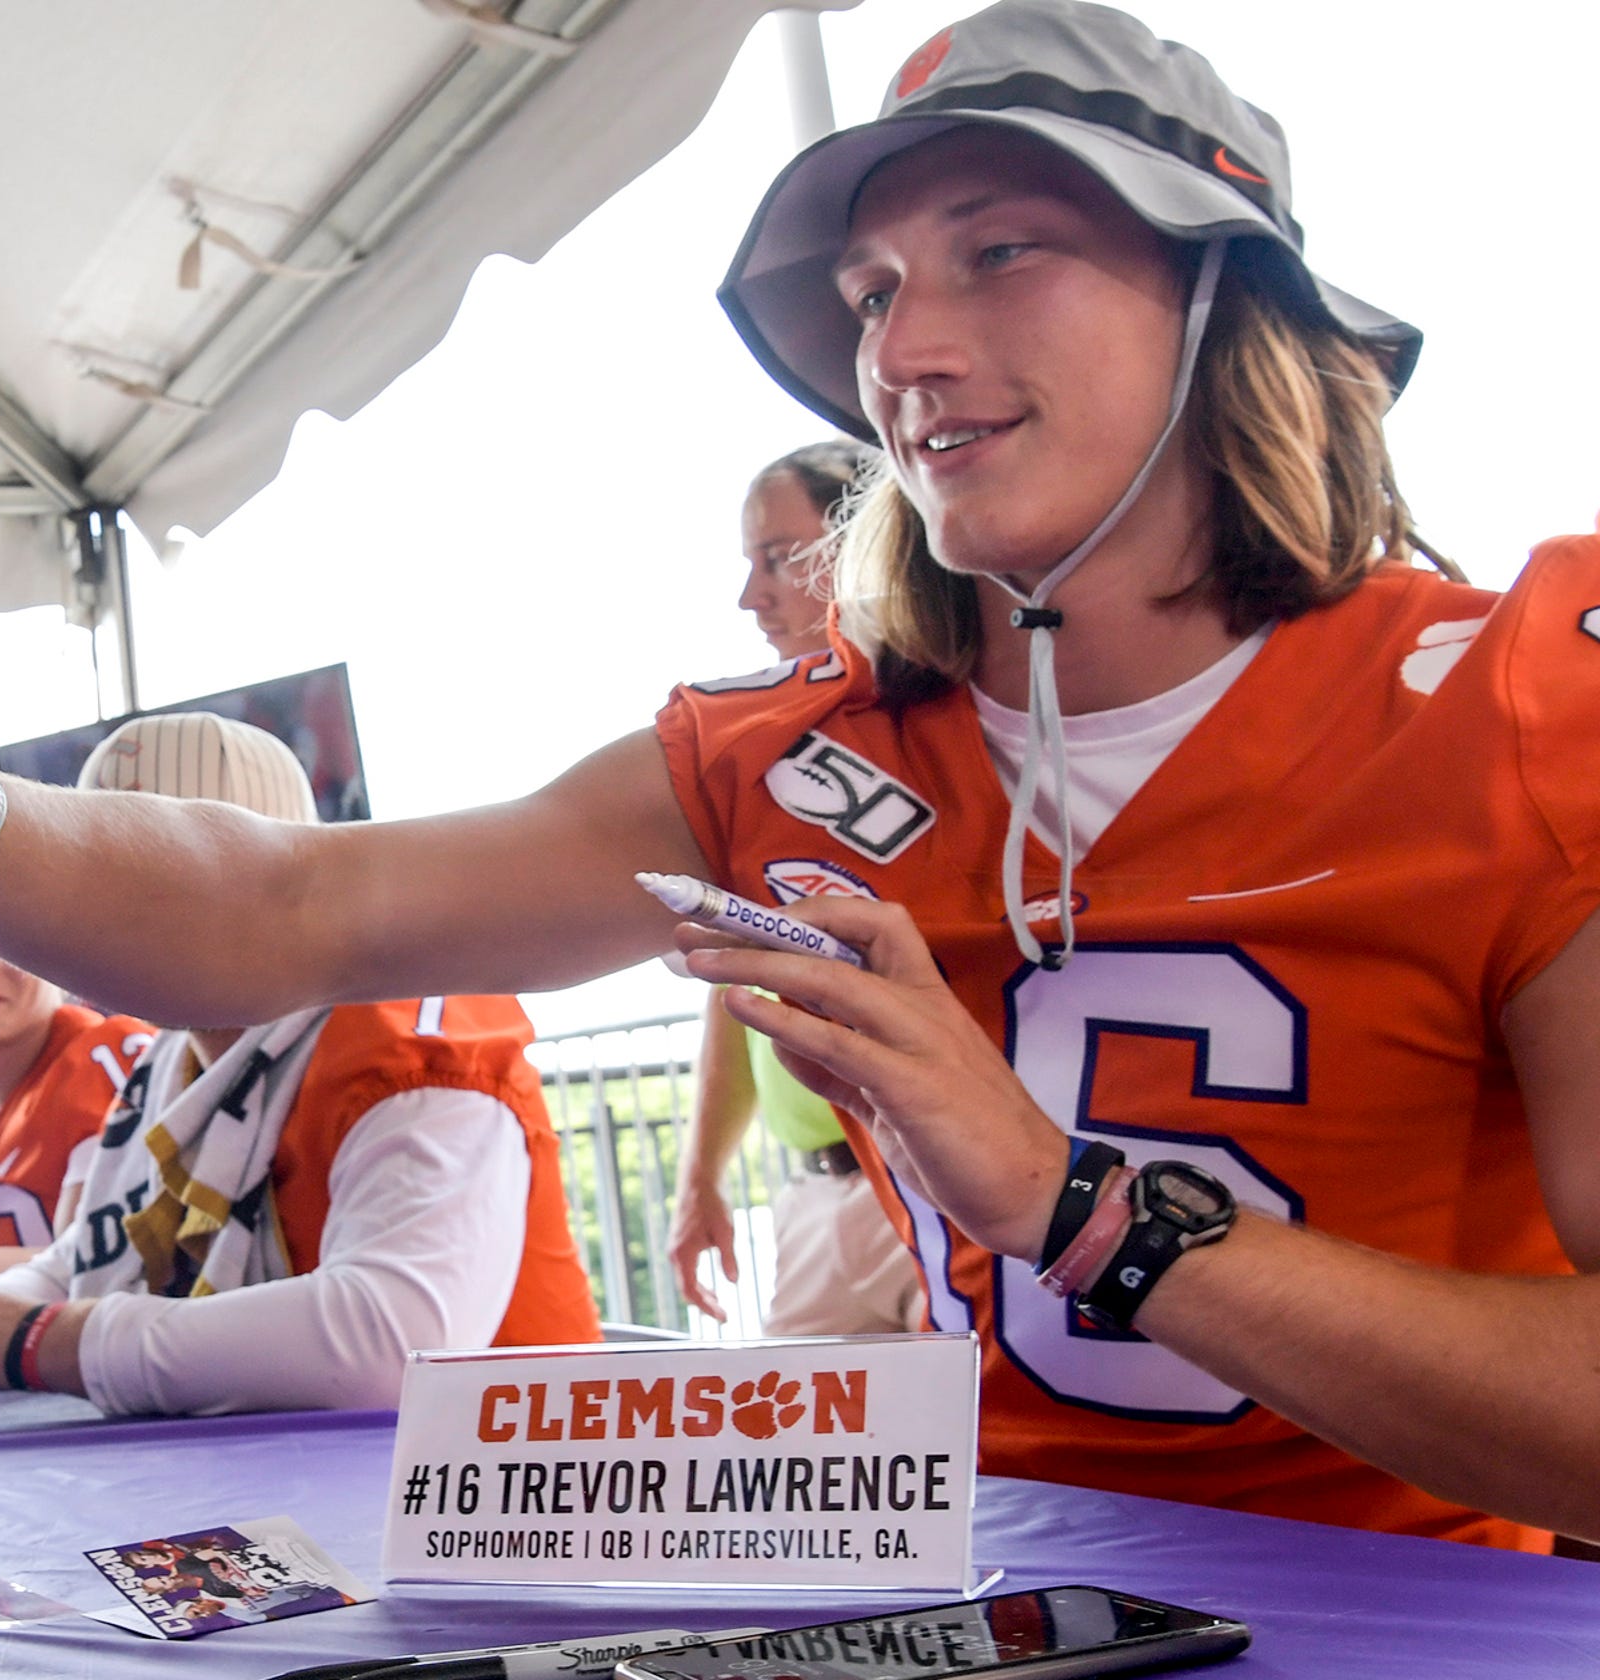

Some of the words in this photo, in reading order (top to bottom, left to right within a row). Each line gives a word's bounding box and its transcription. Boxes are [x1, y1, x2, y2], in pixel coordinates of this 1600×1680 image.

[478, 1370, 867, 1442] CLEMSON
[403, 1463, 480, 1515] #16
[497, 1459, 667, 1515] TREVOR
[685, 1453, 950, 1512] LAWRENCE
[426, 1530, 574, 1559] SOPHOMORE
[601, 1529, 633, 1559] QB
[661, 1529, 861, 1563] CARTERSVILLE,
[875, 1528, 918, 1559] GA.
[557, 1642, 643, 1670] Sharpie
